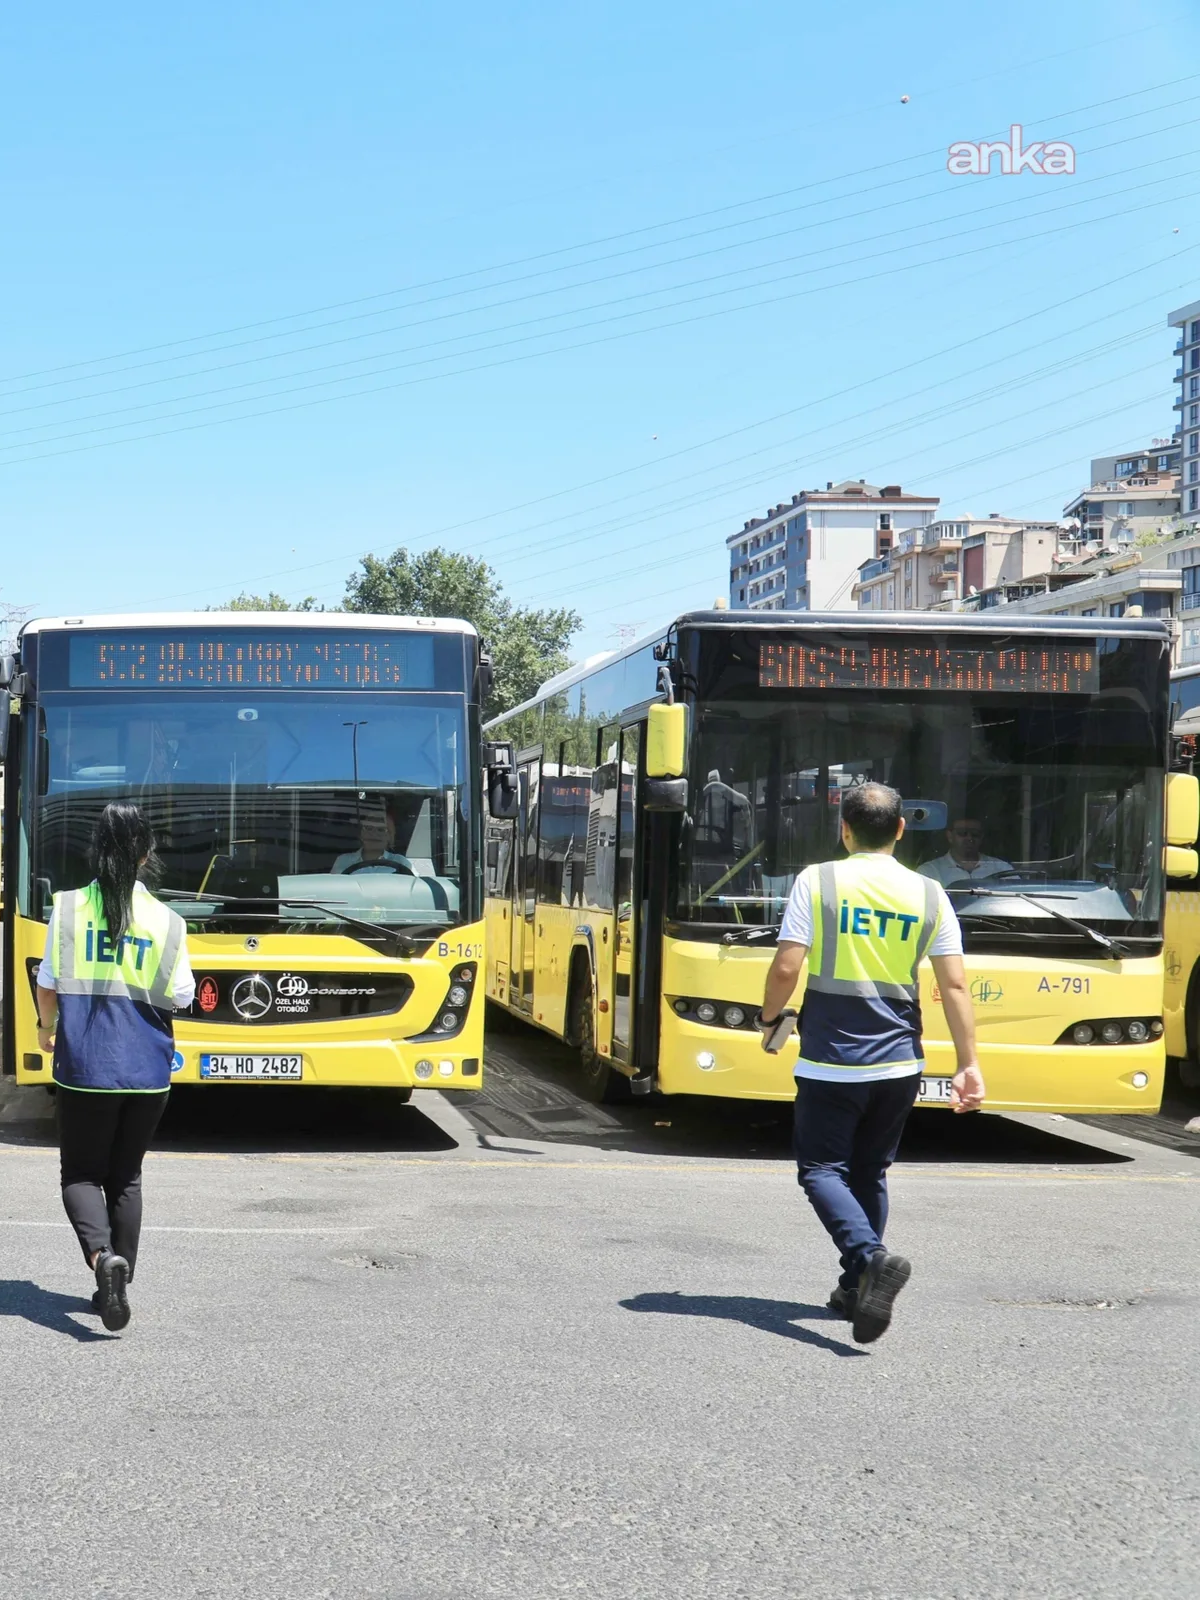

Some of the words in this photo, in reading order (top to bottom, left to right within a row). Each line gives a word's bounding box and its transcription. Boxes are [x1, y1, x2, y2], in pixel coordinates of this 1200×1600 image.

[438, 943, 482, 958] B-1612
[1037, 976, 1091, 994] A-791
[211, 1057, 228, 1073] 34
[236, 1057, 253, 1073] HO
[262, 1057, 298, 1073] 2482
